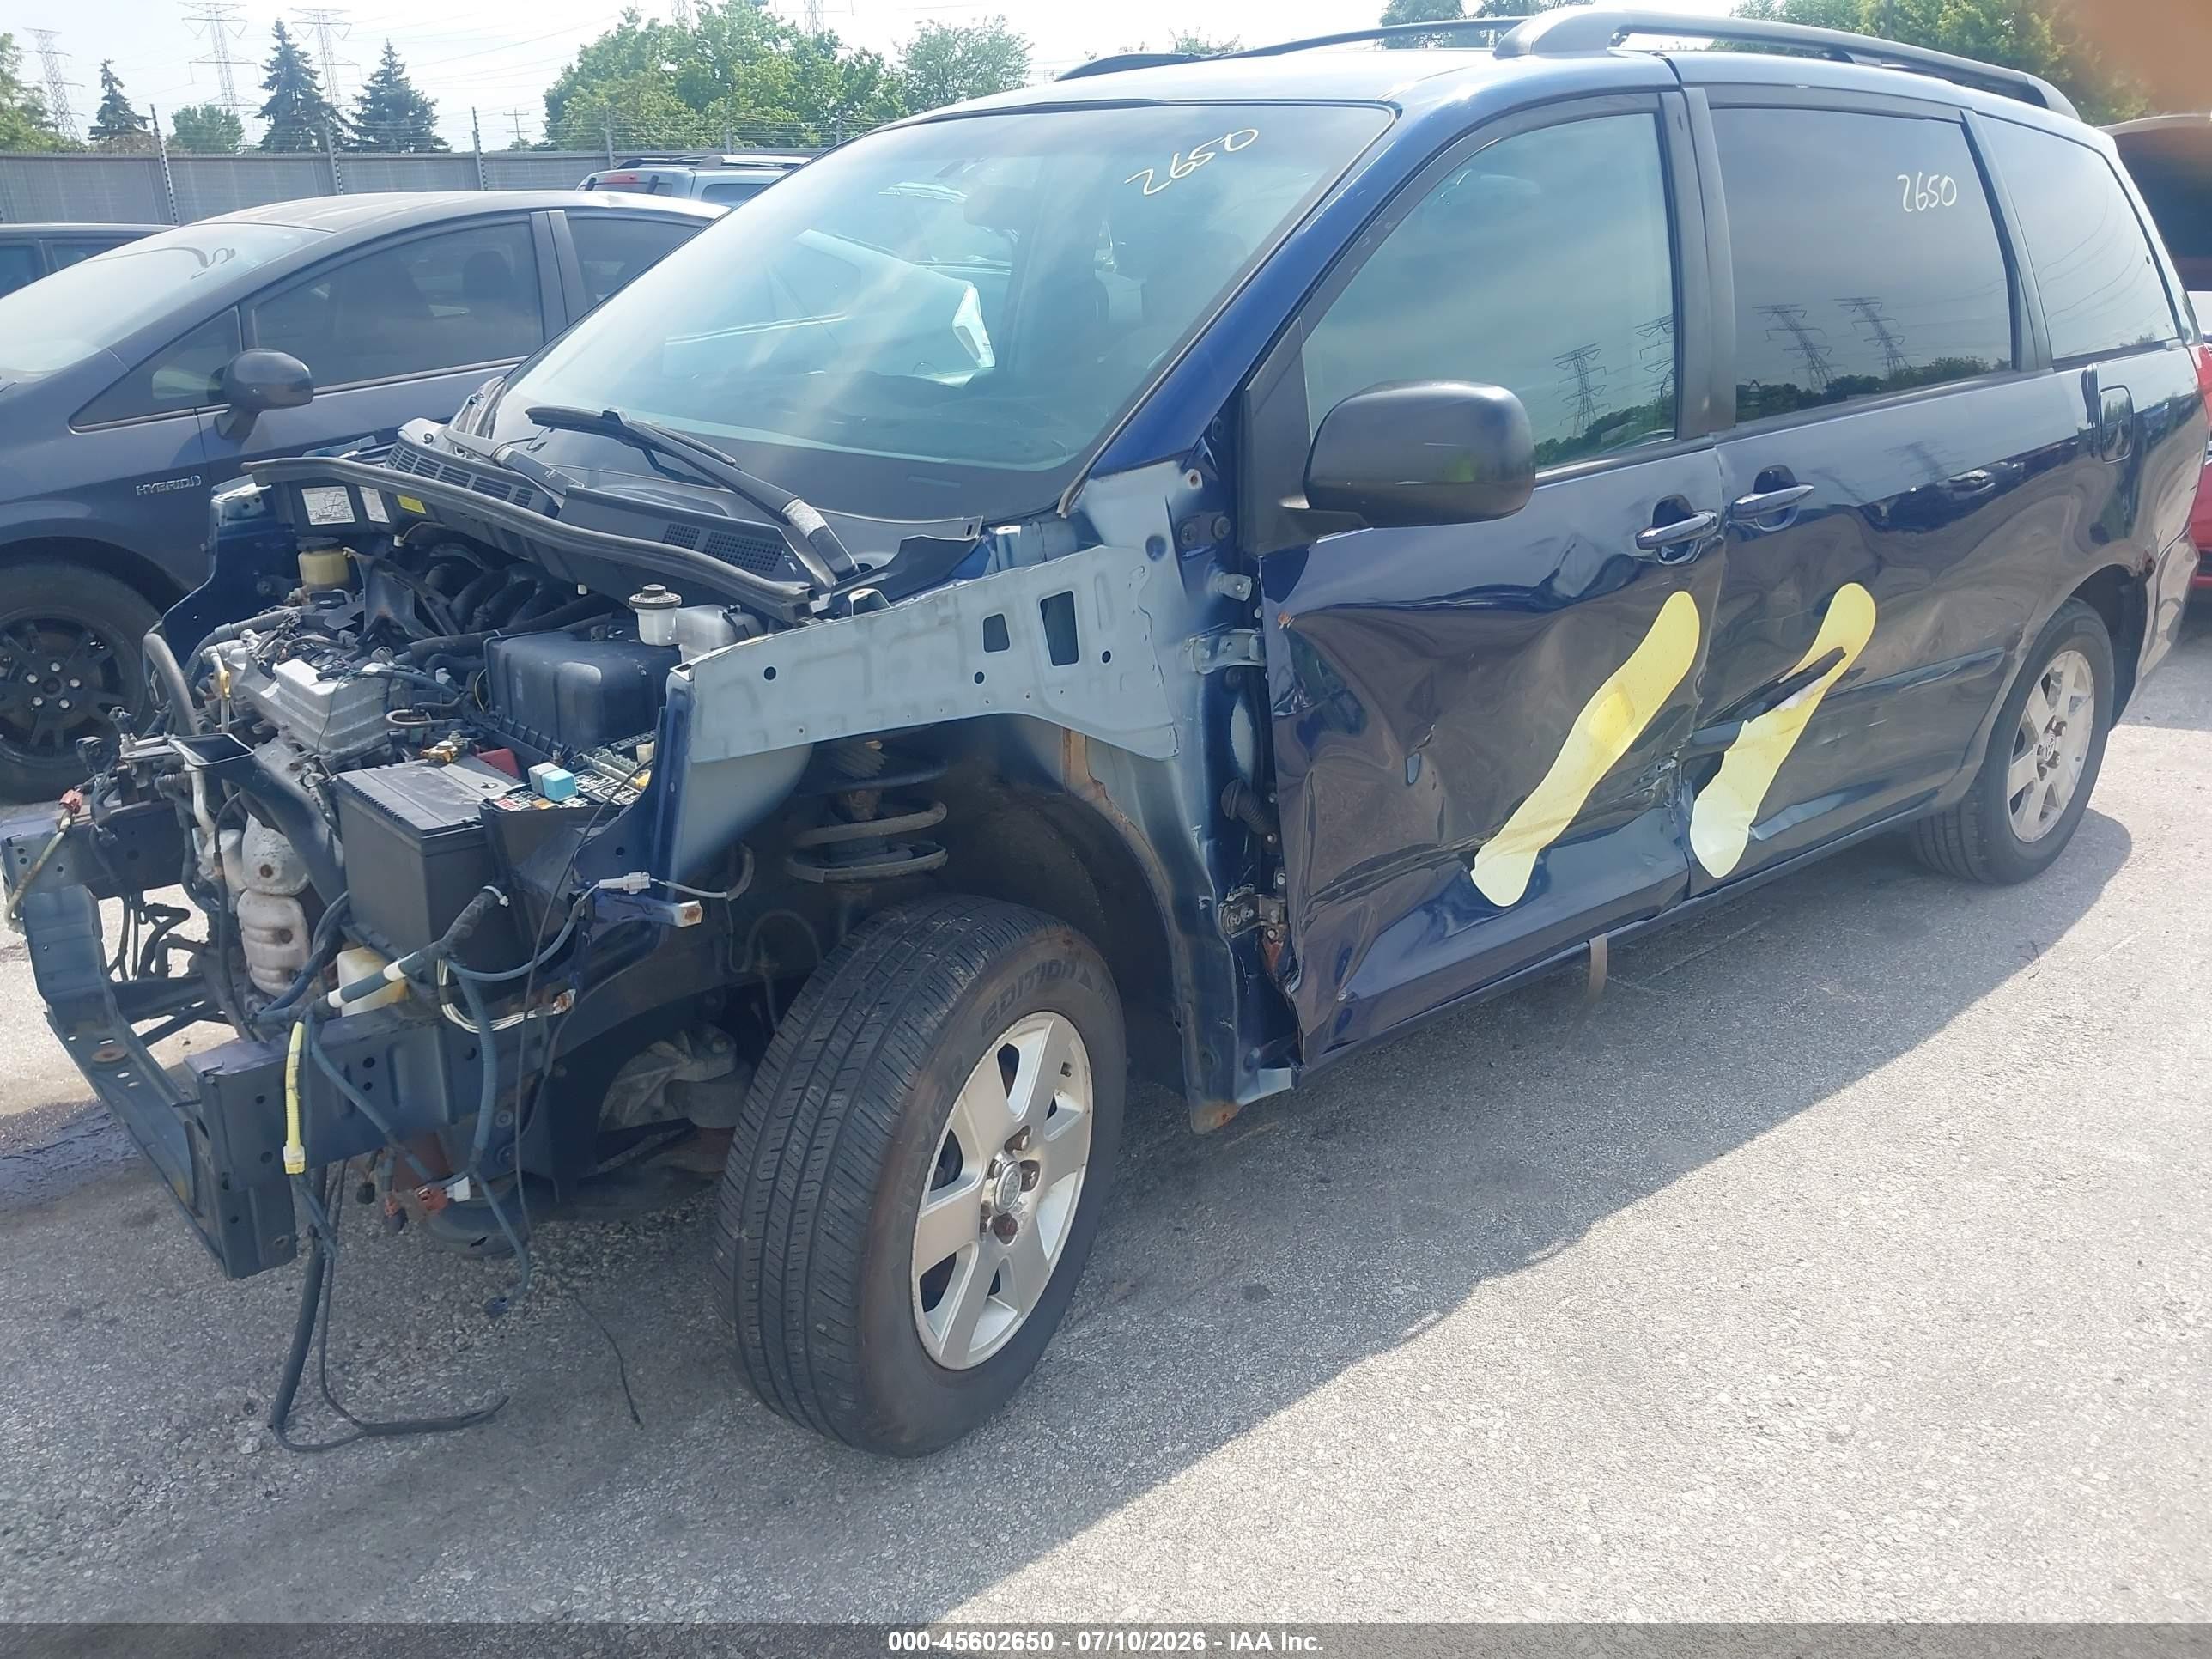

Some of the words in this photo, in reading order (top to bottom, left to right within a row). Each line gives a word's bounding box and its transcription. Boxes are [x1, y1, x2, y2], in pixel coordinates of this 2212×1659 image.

[1124, 128, 1259, 196] 2650
[1897, 171, 1957, 212] 2650
[136, 475, 202, 495] HYBRID
[980, 958, 1078, 1037] EDITION
